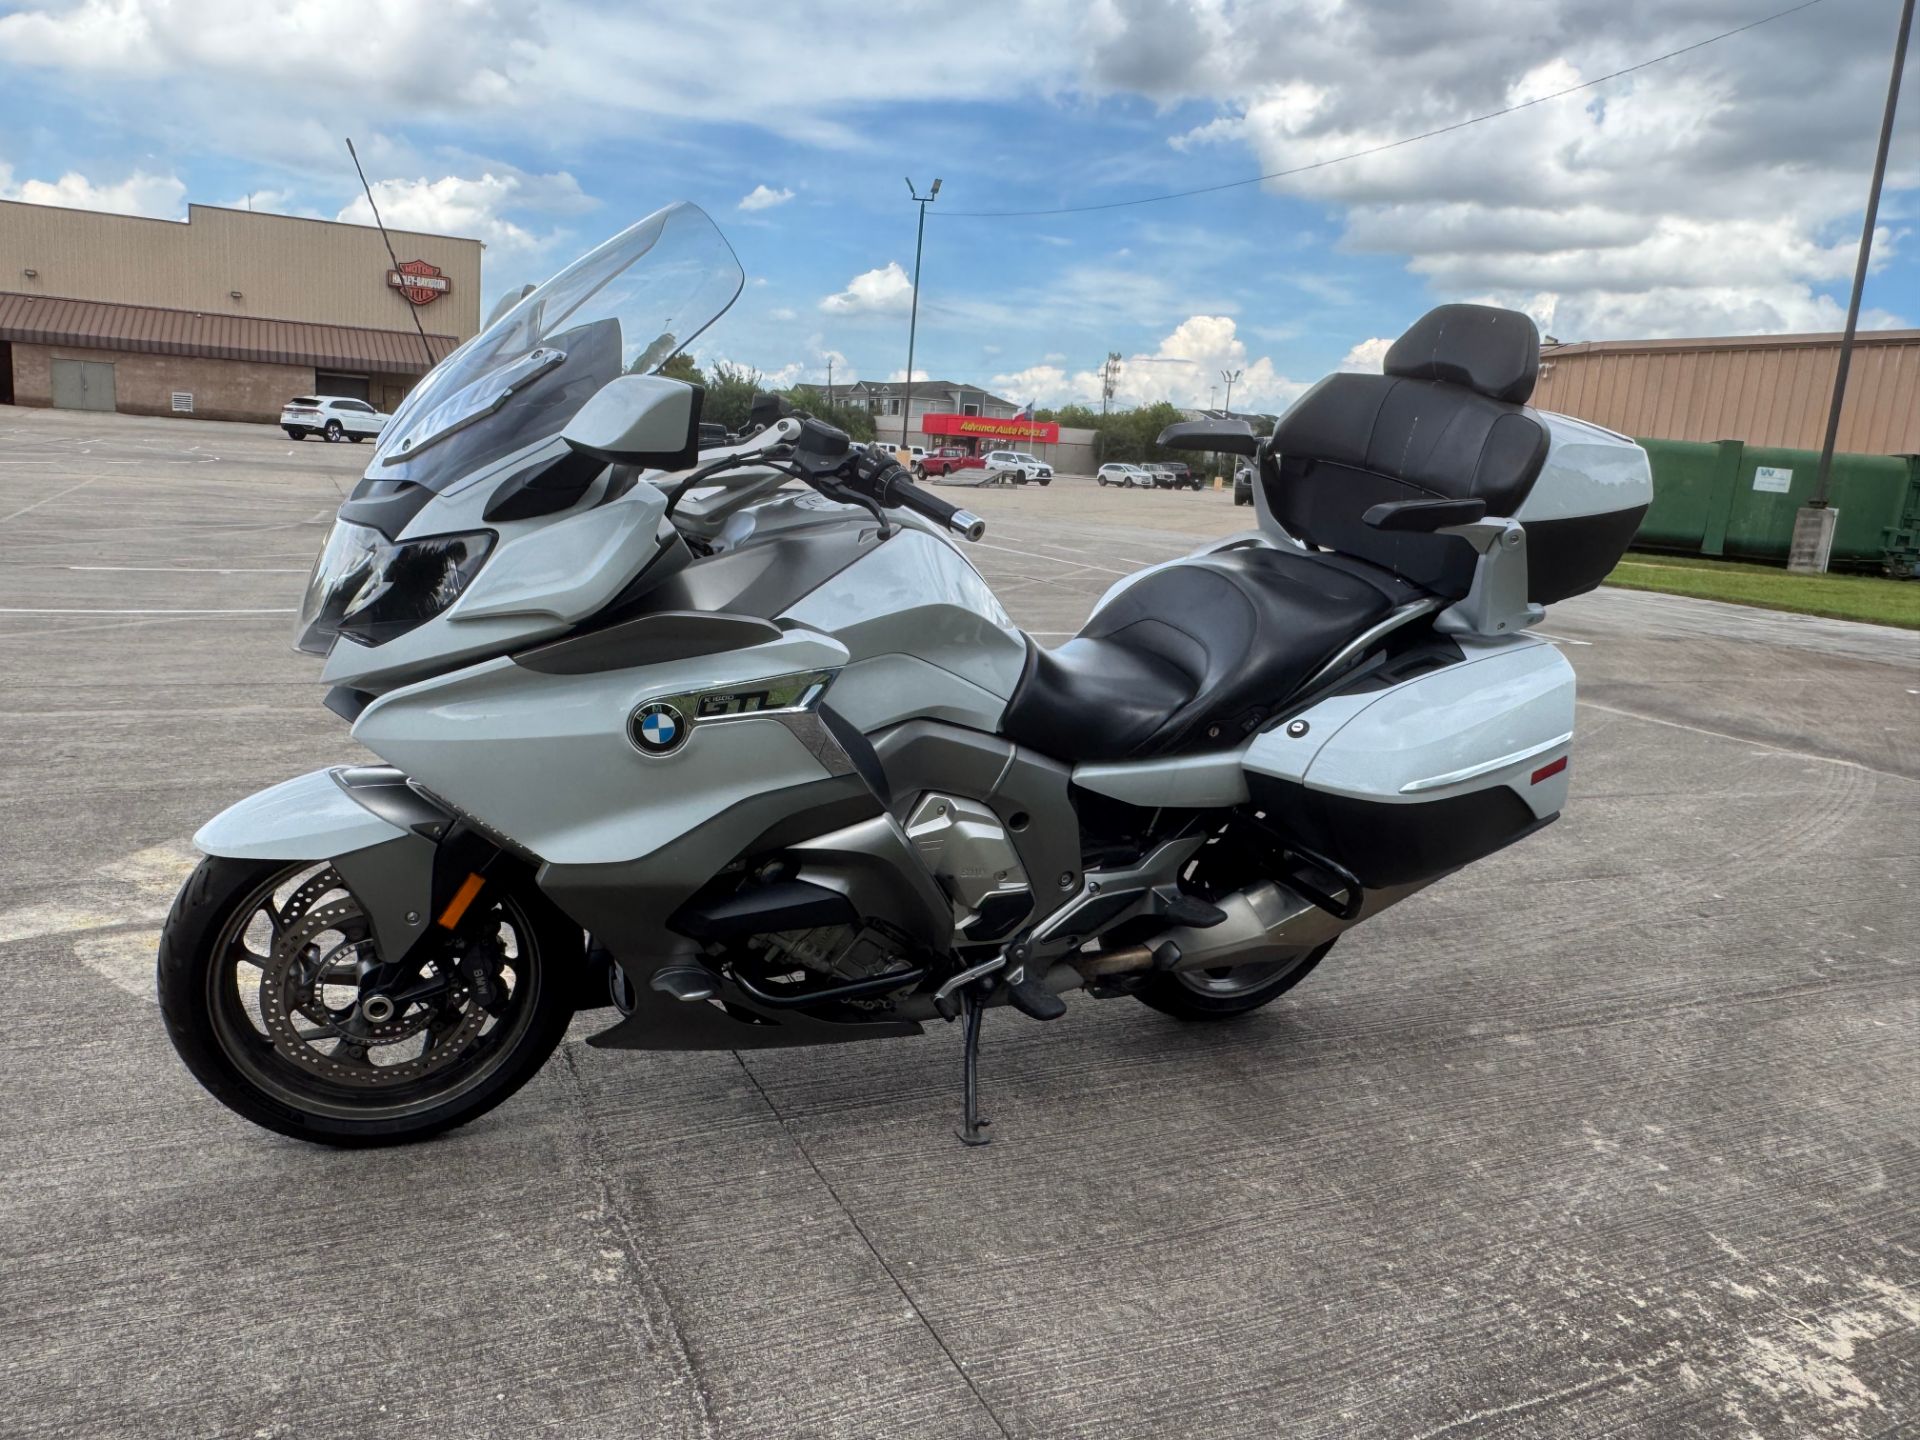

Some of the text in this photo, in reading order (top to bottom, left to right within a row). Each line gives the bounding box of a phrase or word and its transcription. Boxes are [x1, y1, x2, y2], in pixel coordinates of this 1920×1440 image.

[996, 425, 1017, 435] Auto
[635, 704, 680, 722] BMW
[473, 968, 489, 994] BMW
